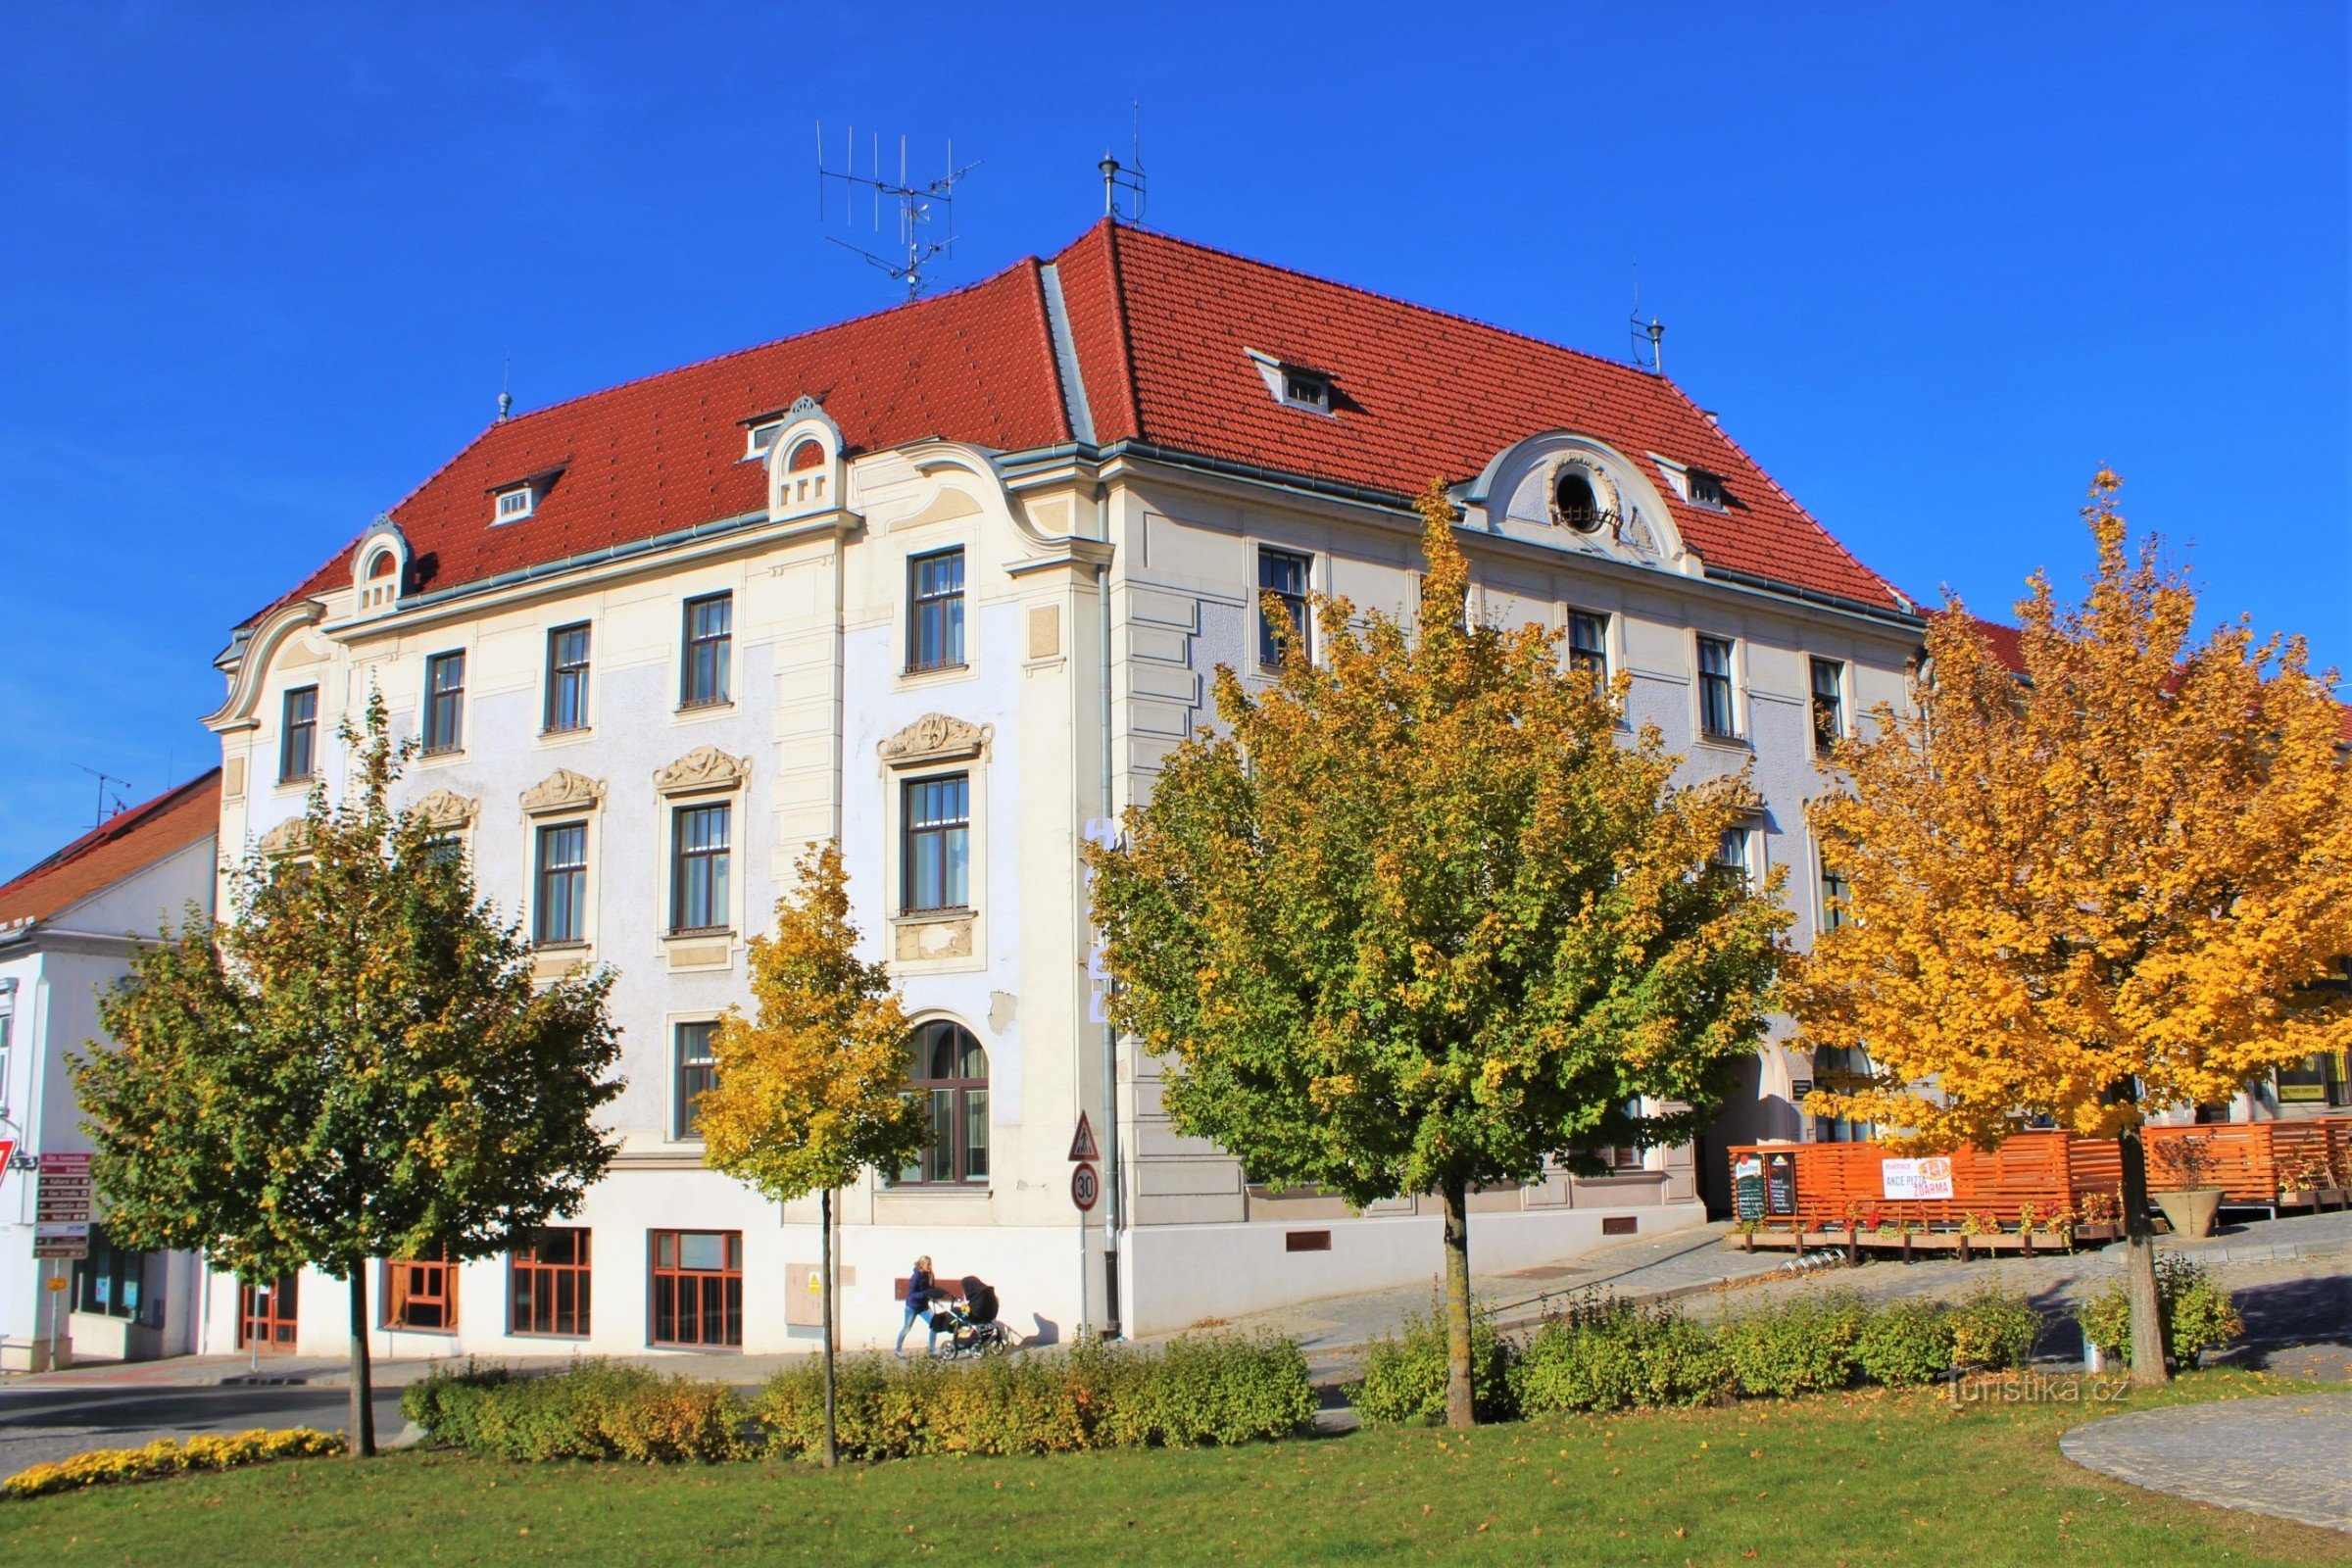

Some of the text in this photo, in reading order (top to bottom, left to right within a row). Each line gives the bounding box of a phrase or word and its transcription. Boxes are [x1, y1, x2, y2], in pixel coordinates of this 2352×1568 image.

[1077, 1175, 1093, 1199] 30
[1886, 1174, 1927, 1187] AKCE PIZZA
[1914, 1181, 1949, 1197] ZDARMA
